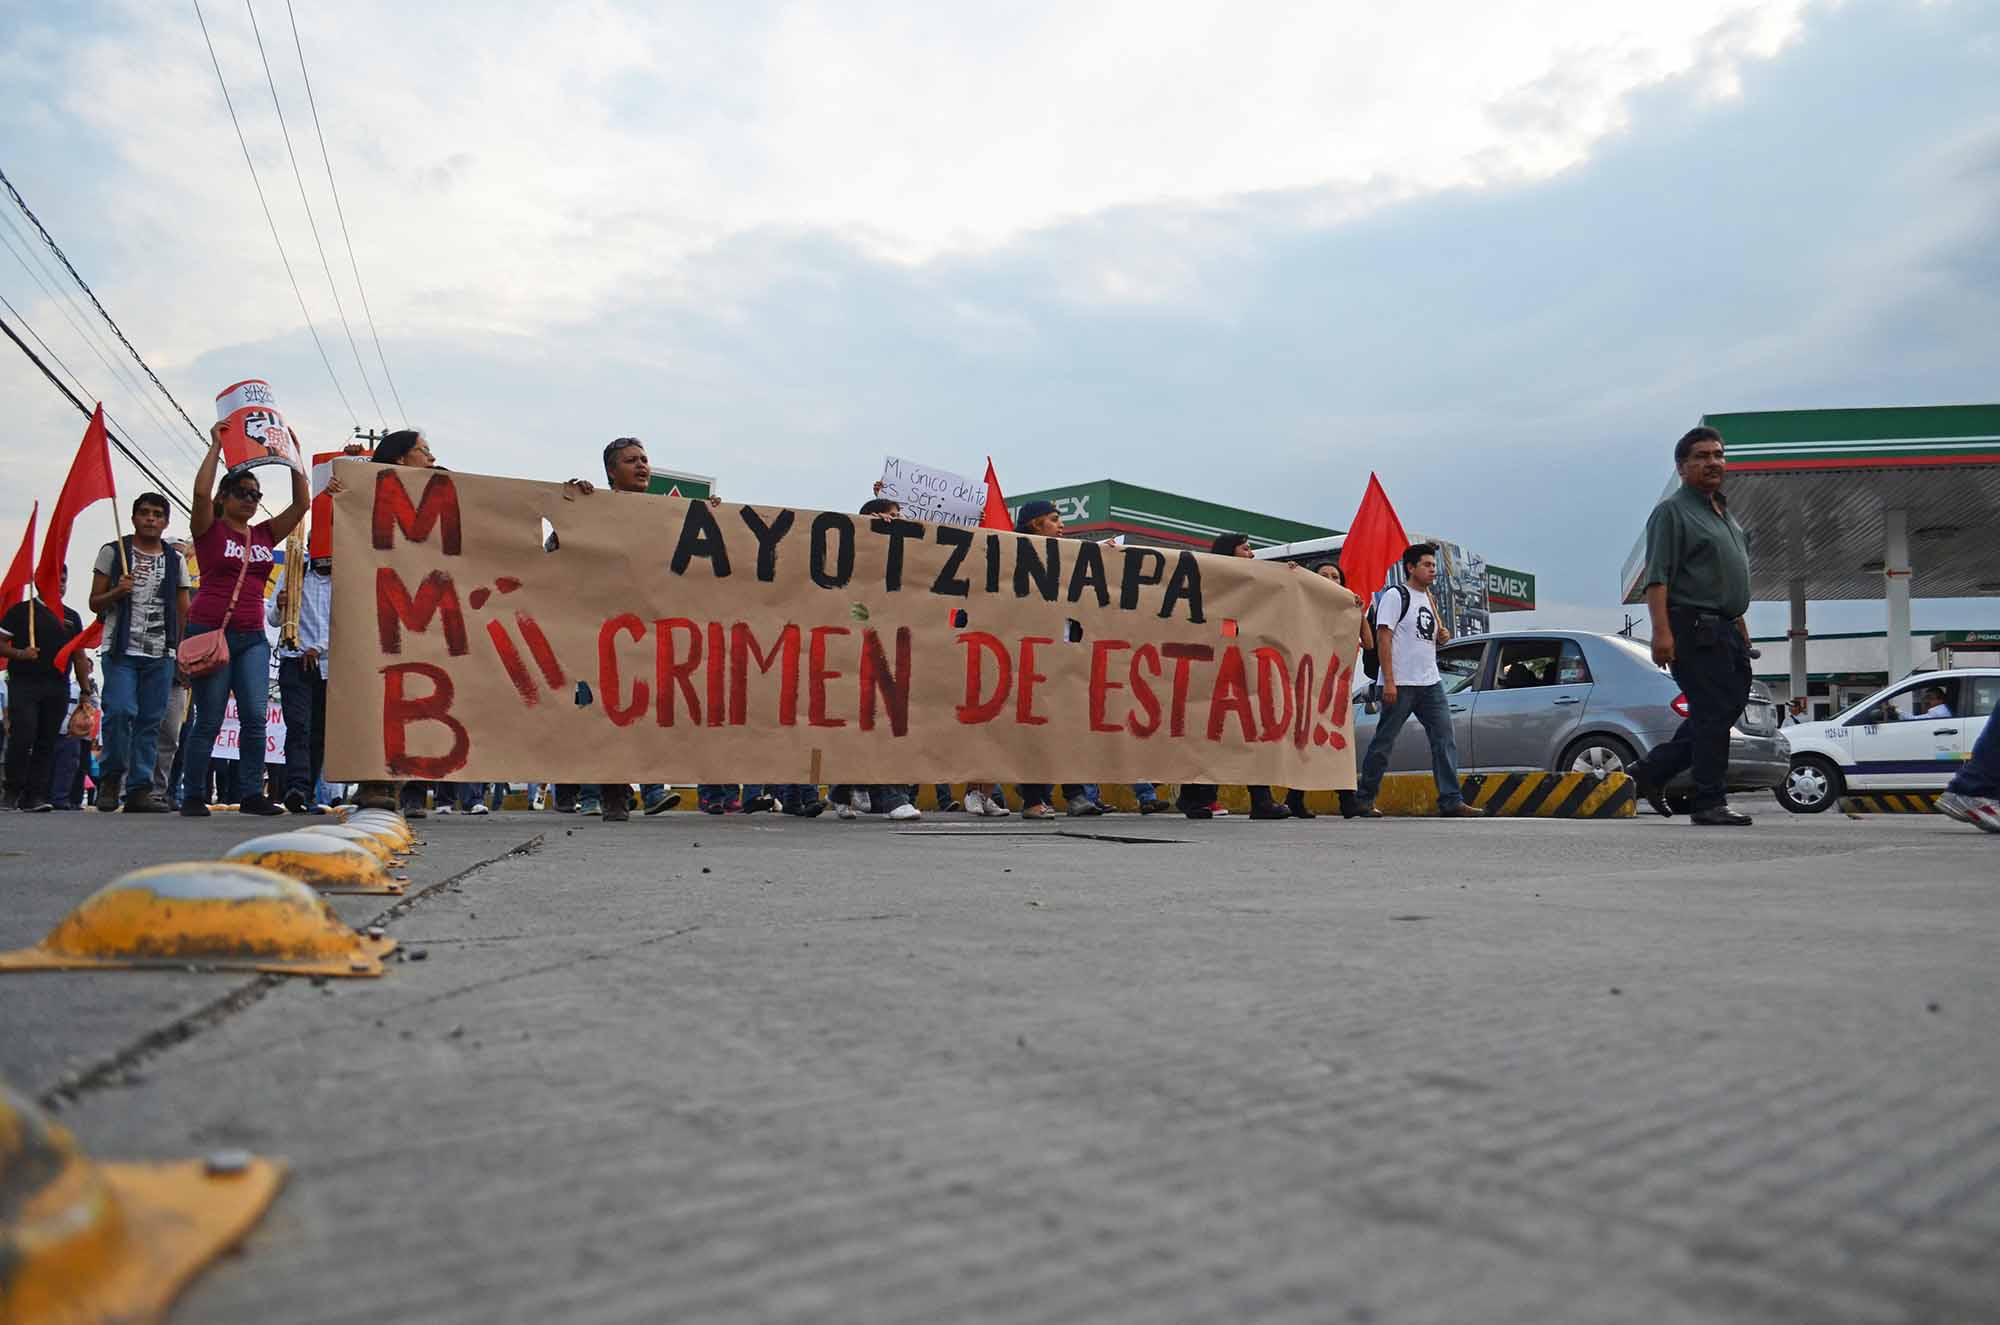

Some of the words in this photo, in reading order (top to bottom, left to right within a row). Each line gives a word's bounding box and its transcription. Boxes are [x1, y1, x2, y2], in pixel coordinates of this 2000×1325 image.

[911, 469, 947, 492] único
[953, 482, 986, 506] delito
[670, 498, 1206, 625] AYOTZINAPA
[1488, 574, 1527, 598] EMEX
[955, 629, 1055, 727] DE
[1088, 639, 1353, 753] ESTADO!!
[1864, 725, 1879, 736] TAXI
